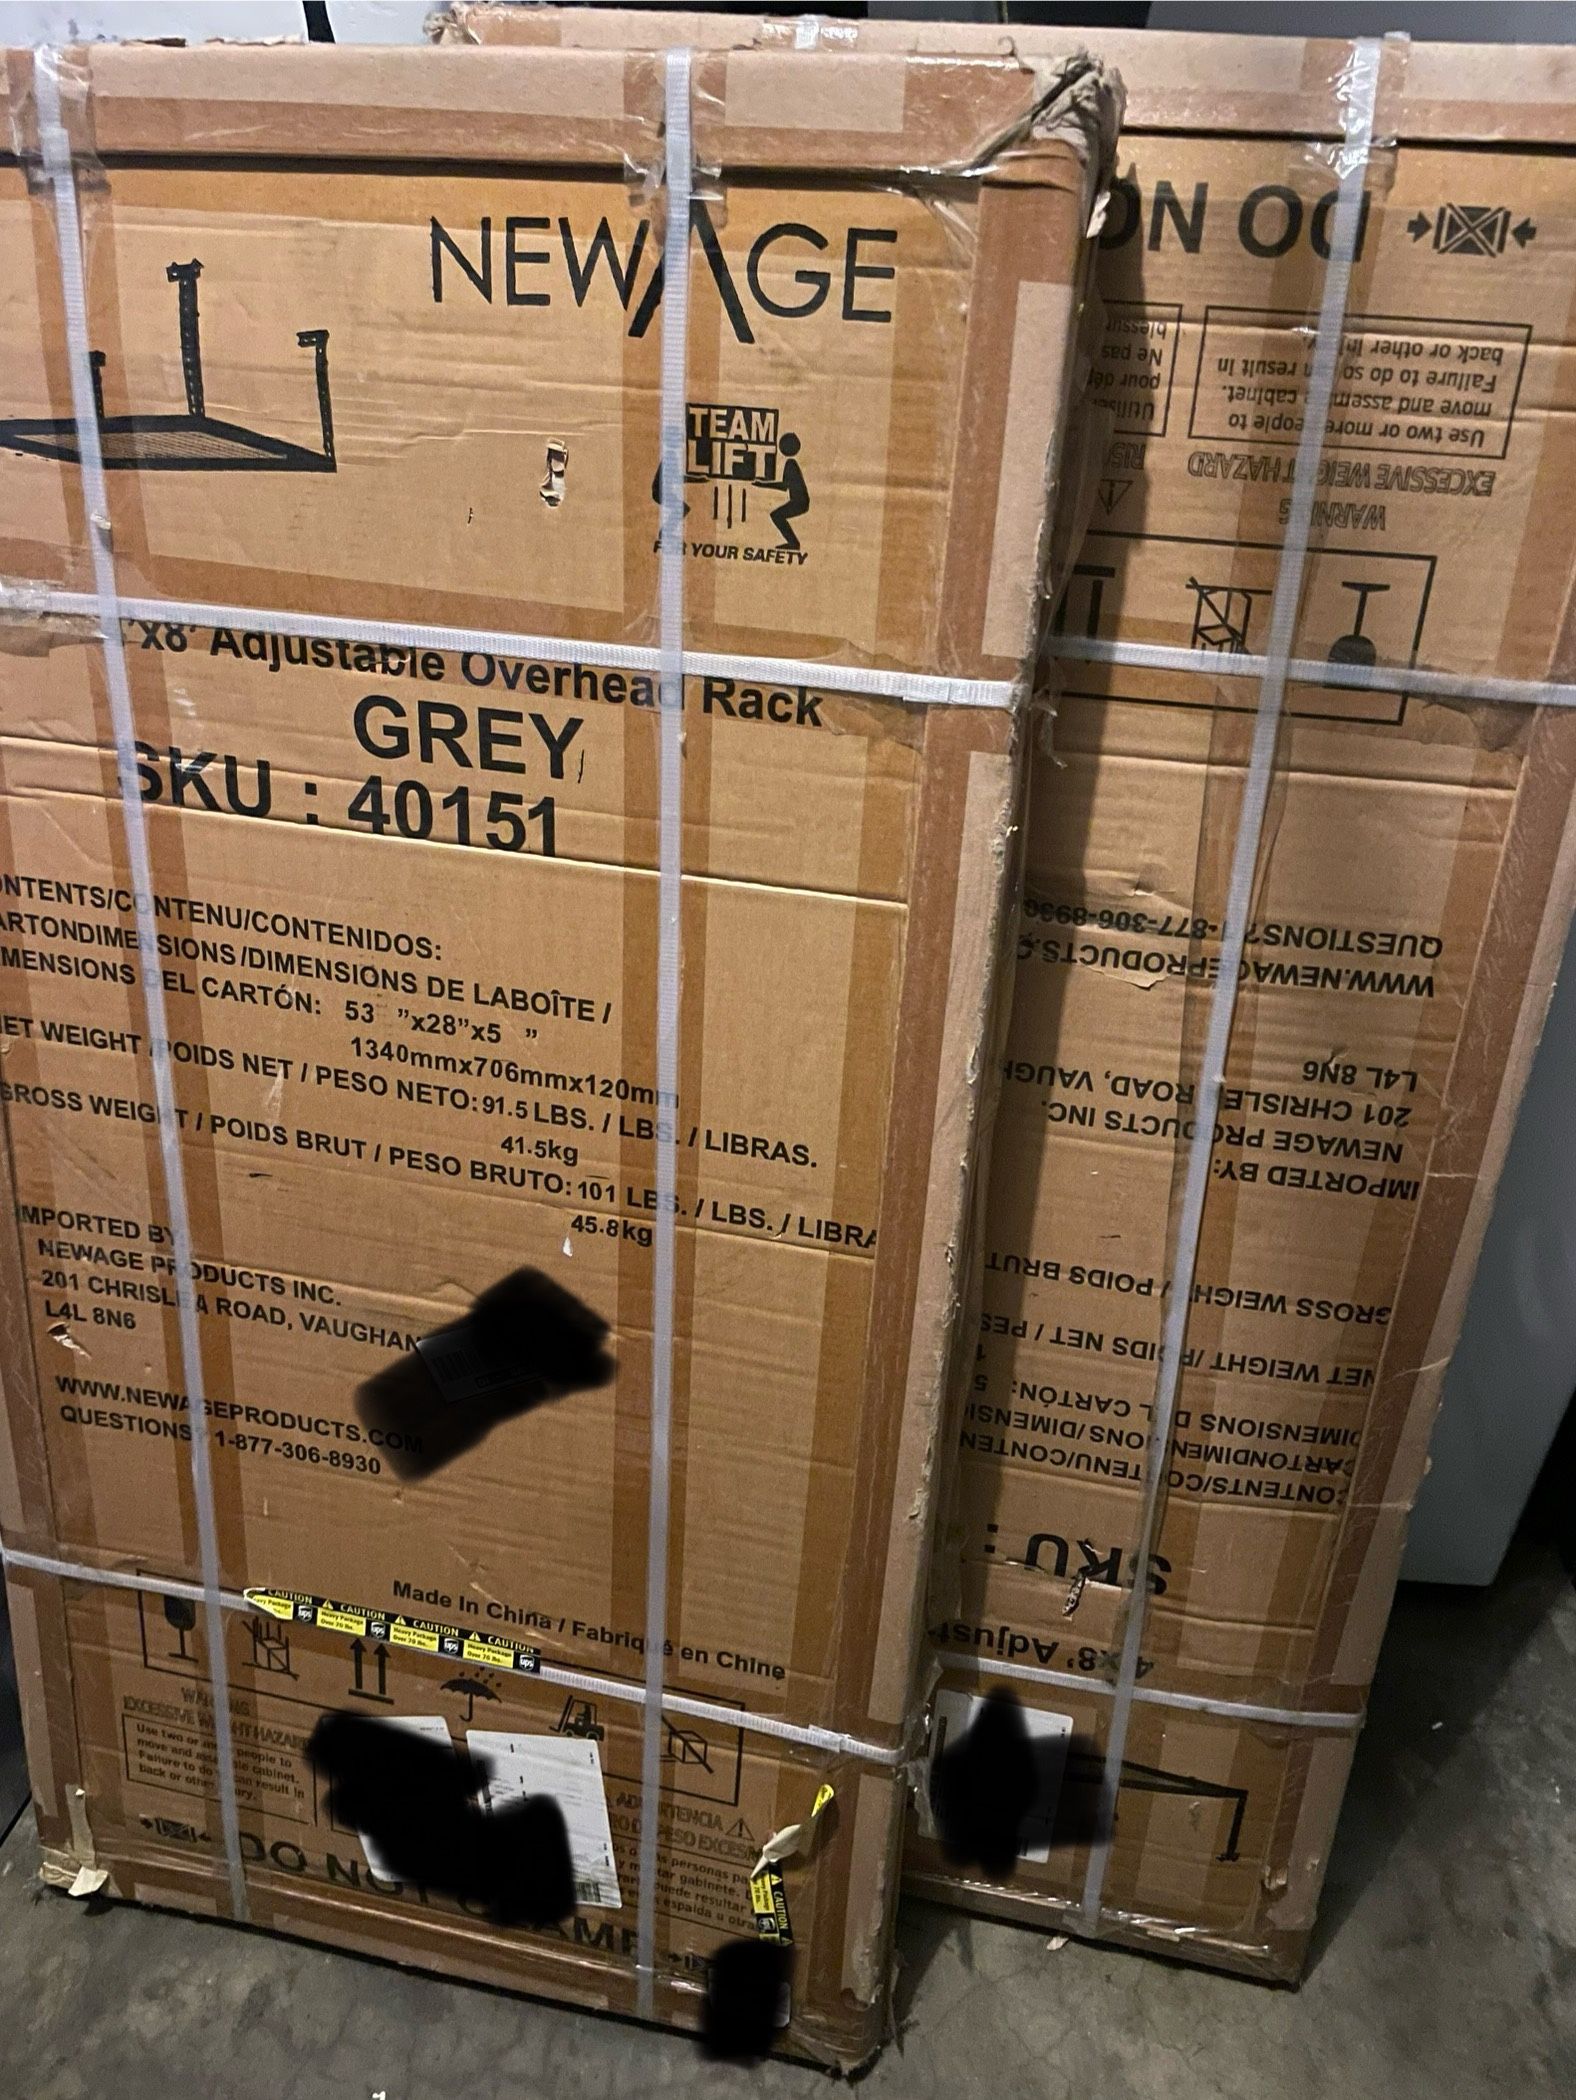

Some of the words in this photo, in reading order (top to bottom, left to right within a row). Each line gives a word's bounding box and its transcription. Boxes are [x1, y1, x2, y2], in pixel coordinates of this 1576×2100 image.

[1098, 179, 1208, 254] NO
[1238, 185, 1372, 262] DO
[1100, 341, 1132, 361] pas
[1136, 345, 1162, 367] Ne
[1371, 339, 1423, 360] other
[1429, 344, 1451, 360] or
[1458, 345, 1503, 366] back
[1218, 357, 1235, 376] in
[1243, 359, 1297, 377] result
[1344, 366, 1364, 380] so
[1371, 367, 1393, 387] do
[1400, 368, 1419, 385] to
[1119, 370, 1161, 391] pour
[1427, 371, 1497, 393] Failure
[1222, 385, 1297, 405] cabinet.
[1398, 396, 1434, 415] and
[1441, 399, 1492, 417] move
[687, 405, 775, 443] TEAM
[1229, 414, 1247, 430] to
[1253, 411, 1304, 433] eople
[1326, 419, 1373, 437] more
[1379, 424, 1400, 440] or
[1406, 425, 1442, 445] two
[1449, 428, 1485, 448] Use
[686, 443, 777, 480] LIFT
[1188, 452, 1278, 482] HAZARD
[1282, 458, 1371, 488] WEIGT
[1373, 463, 1496, 497] EXCESSIVE
[1279, 499, 1385, 531] WARNIG
[692, 542, 738, 559] YOUR
[743, 548, 808, 565] SAFETY
[210, 626, 446, 683] Adjustable
[703, 676, 824, 728] Rack
[352, 693, 584, 780] GREY
[118, 740, 271, 818] SKU
[305, 782, 319, 826] :
[347, 774, 557, 858] 40151
[1246, 923, 1443, 959] QUESTIONS?
[201, 976, 321, 1015] CARTÓN:
[345, 1000, 374, 1023] 53
[427, 976, 464, 1004] DE
[473, 982, 595, 1022] LABOÎTE
[603, 1003, 611, 1024] /
[1302, 1060, 1357, 1086] 8N6
[1366, 1065, 1418, 1092] L4L
[41, 1019, 141, 1055] WEIGHT
[243, 1053, 293, 1080] NET
[301, 1062, 308, 1083] /
[316, 1066, 388, 1096] PESO
[534, 1105, 594, 1132] LBS.
[602, 1113, 611, 1134] /
[688, 1127, 697, 1147] /
[705, 1130, 818, 1168] LIBRAS.
[1103, 1070, 1195, 1105] ROAD,
[1041, 1100, 1096, 1127] INC.
[1363, 1104, 1412, 1128] 201
[501, 1136, 579, 1167] 41.5kg
[1273, 1129, 1403, 1164] NEWAGE
[89, 1092, 188, 1130] WEIGT
[195, 1113, 203, 1131] /
[211, 1115, 288, 1145] POIDS
[297, 1130, 366, 1160] BRUT
[373, 1144, 381, 1163] /
[389, 1147, 461, 1176] PESO
[695, 1199, 704, 1219] /
[712, 1202, 773, 1231] LBS.
[781, 1213, 791, 1237] /
[1212, 1158, 1259, 1182] BY:
[1267, 1165, 1420, 1201] IMPORTED
[15, 1204, 140, 1240] IMPORTED
[571, 1215, 653, 1247] 45.8kg
[38, 1238, 144, 1271] NEWAGE
[293, 1279, 342, 1306] INC.
[984, 1252, 1060, 1281] BRUT
[1068, 1265, 1154, 1296] POIDS
[41, 1269, 78, 1292] 201
[216, 1297, 293, 1331] ROAD,
[1296, 1298, 1392, 1325] GROSS
[45, 1300, 88, 1322] L4L
[93, 1305, 136, 1330] 8N6
[1034, 1323, 1044, 1341] /
[1049, 1326, 1104, 1352] NET
[1209, 1352, 1320, 1383] WEIGHT
[1010, 1380, 1131, 1419] CARTÓN:
[214, 1429, 381, 1476] 1-877-306-8930
[1025, 1533, 1172, 1596] SKU
[268, 1589, 312, 1605] CAUTION
[298, 1609, 312, 1620] ups
[340, 1604, 385, 1620] CAUTION
[371, 1626, 385, 1636] ups
[393, 1580, 452, 1608] Made
[486, 1602, 551, 1629] China
[559, 1618, 566, 1632] /
[680, 1646, 708, 1663] en
[716, 1651, 786, 1680] Chine
[413, 1620, 459, 1636] CAUTION
[444, 1642, 459, 1652] ups
[488, 1636, 534, 1653] CAUTION
[519, 1658, 534, 1667] ups
[137, 1723, 158, 1735] Use
[161, 1729, 183, 1743] two
[137, 1738, 168, 1751] move
[172, 1745, 192, 1758] and
[252, 1765, 300, 1784] cabinet.
[138, 1750, 180, 1769] Failure
[139, 1763, 165, 1778] back
[680, 1873, 740, 1897] gabinete.
[774, 1891, 789, 1930] CAUTION
